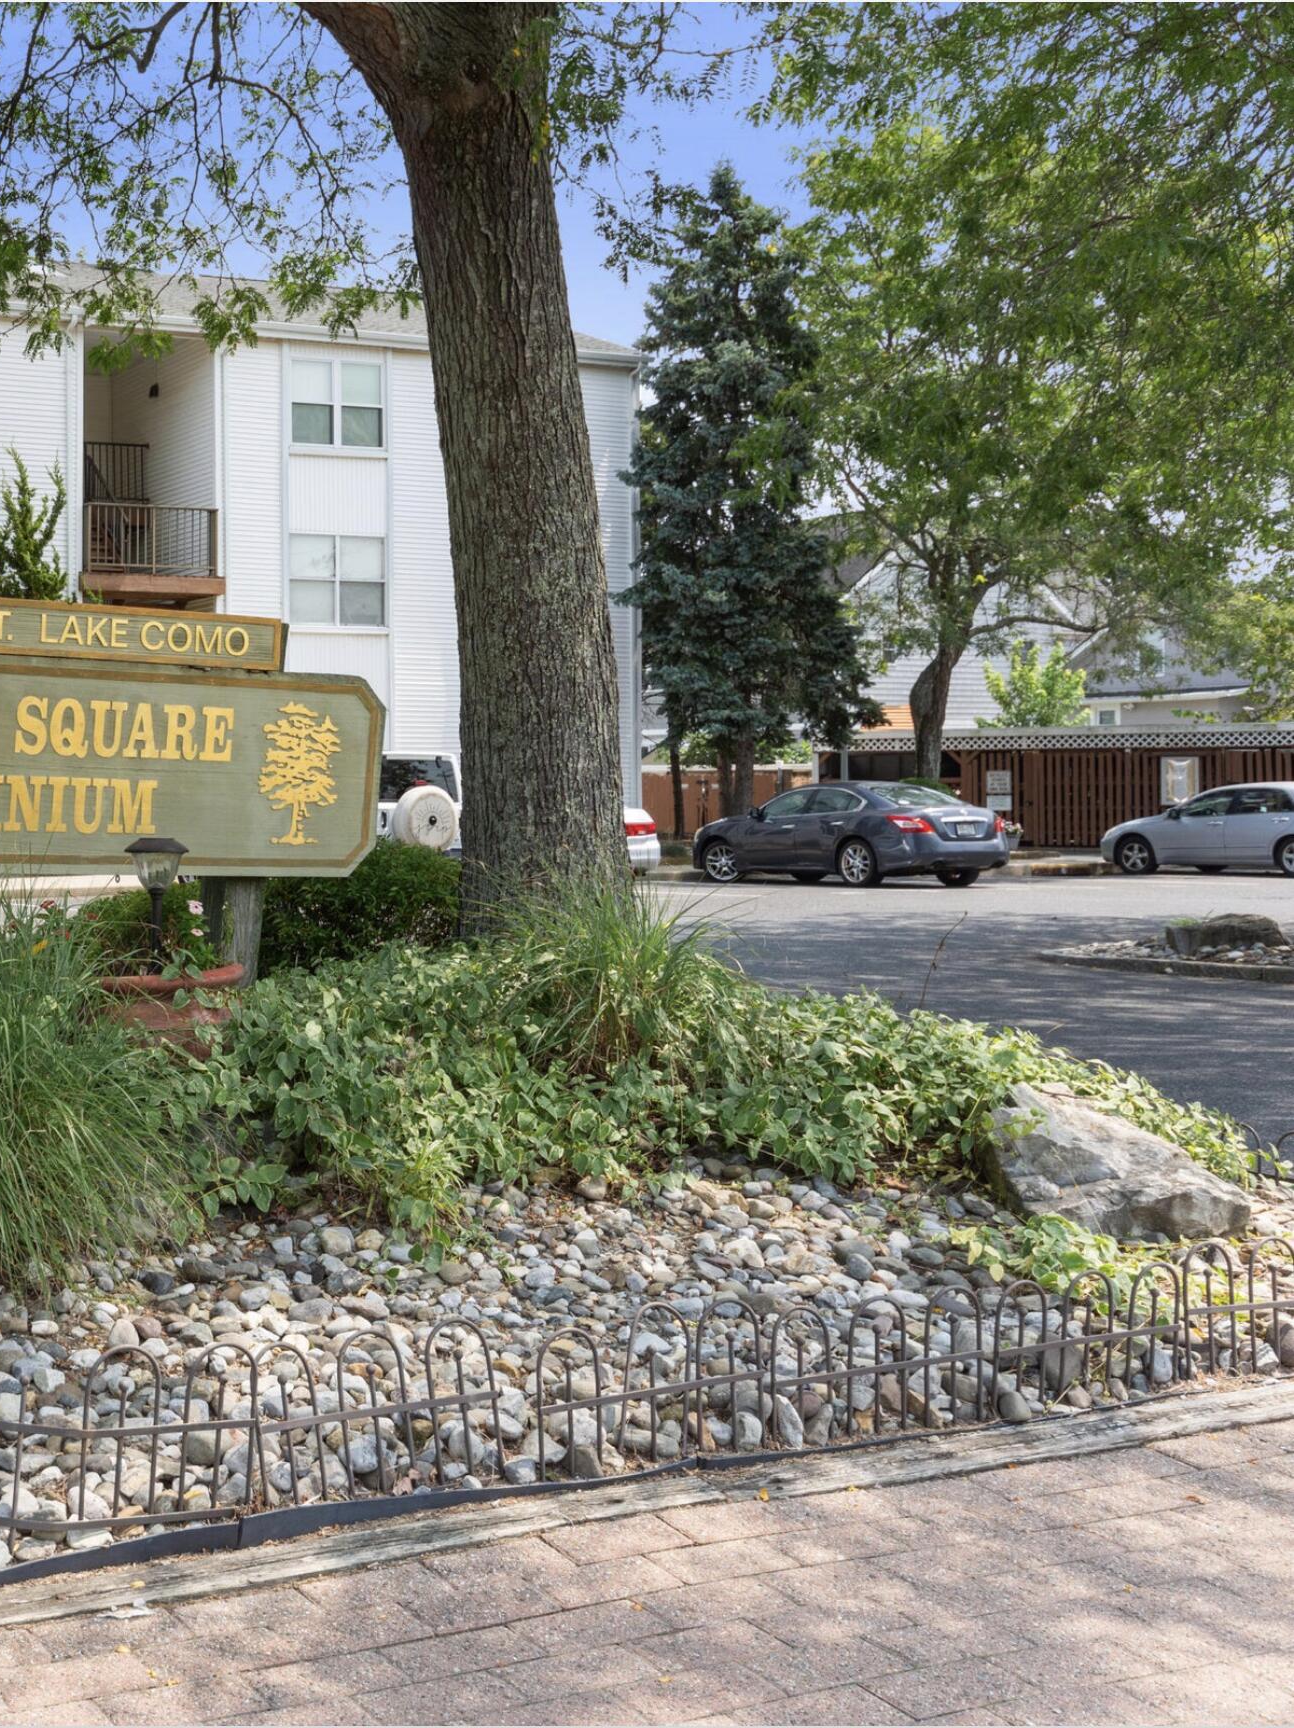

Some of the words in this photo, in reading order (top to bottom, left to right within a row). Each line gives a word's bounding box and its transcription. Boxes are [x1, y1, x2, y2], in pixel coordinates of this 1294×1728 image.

[39, 612, 130, 649] LAKE
[140, 620, 250, 657] COMO
[14, 695, 235, 762] SQUARE
